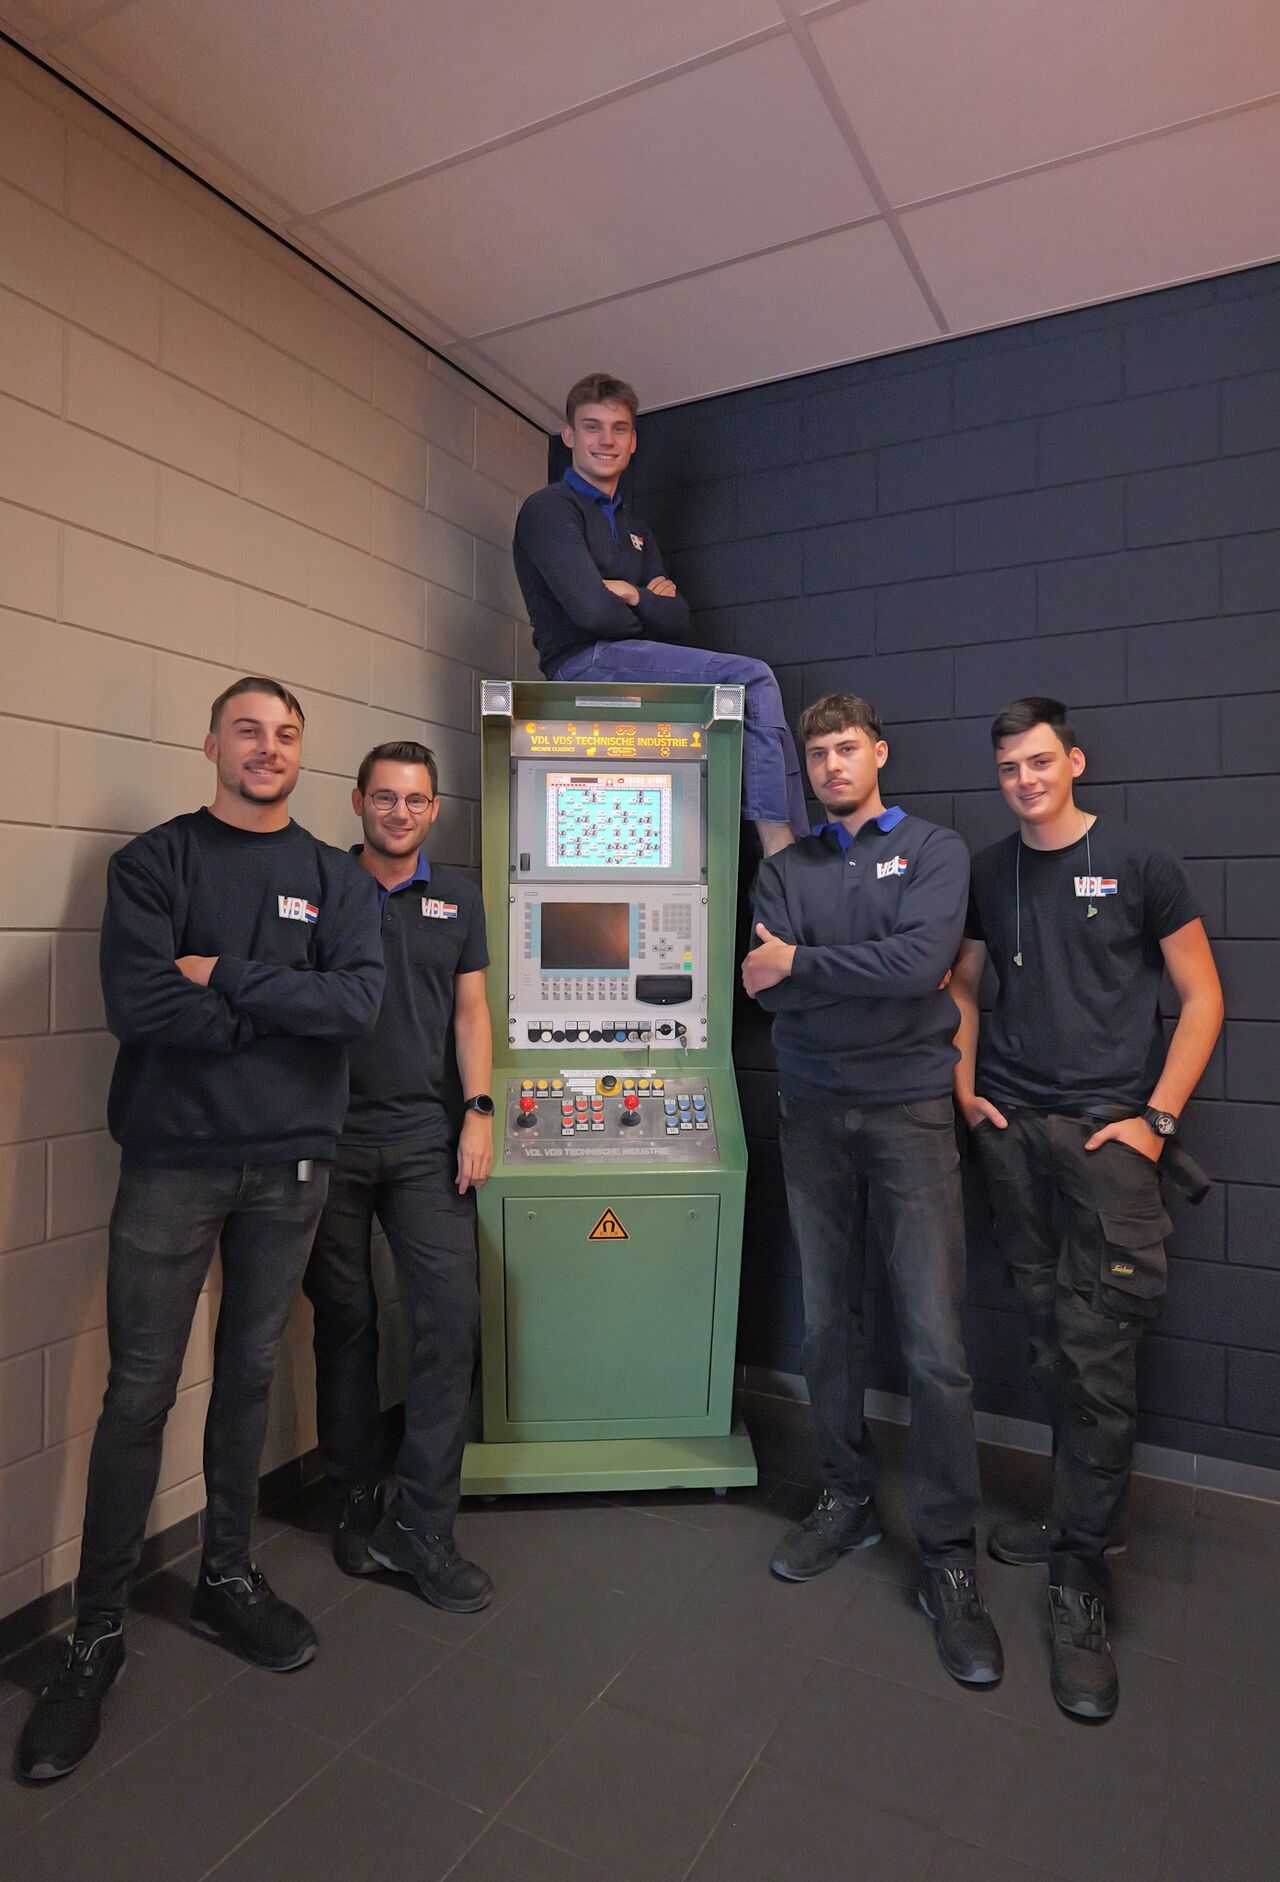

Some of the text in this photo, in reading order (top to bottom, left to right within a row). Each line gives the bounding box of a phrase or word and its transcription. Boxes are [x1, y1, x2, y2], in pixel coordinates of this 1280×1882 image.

[531, 736, 688, 747] VDL VDS TECHNISCHE INDUSTRIE
[1074, 877, 1106, 897] VDL
[278, 895, 309, 923] VDL
[422, 897, 449, 919] VDL
[525, 1149, 543, 1157] VDL
[565, 1148, 620, 1156] TECHNISCHE
